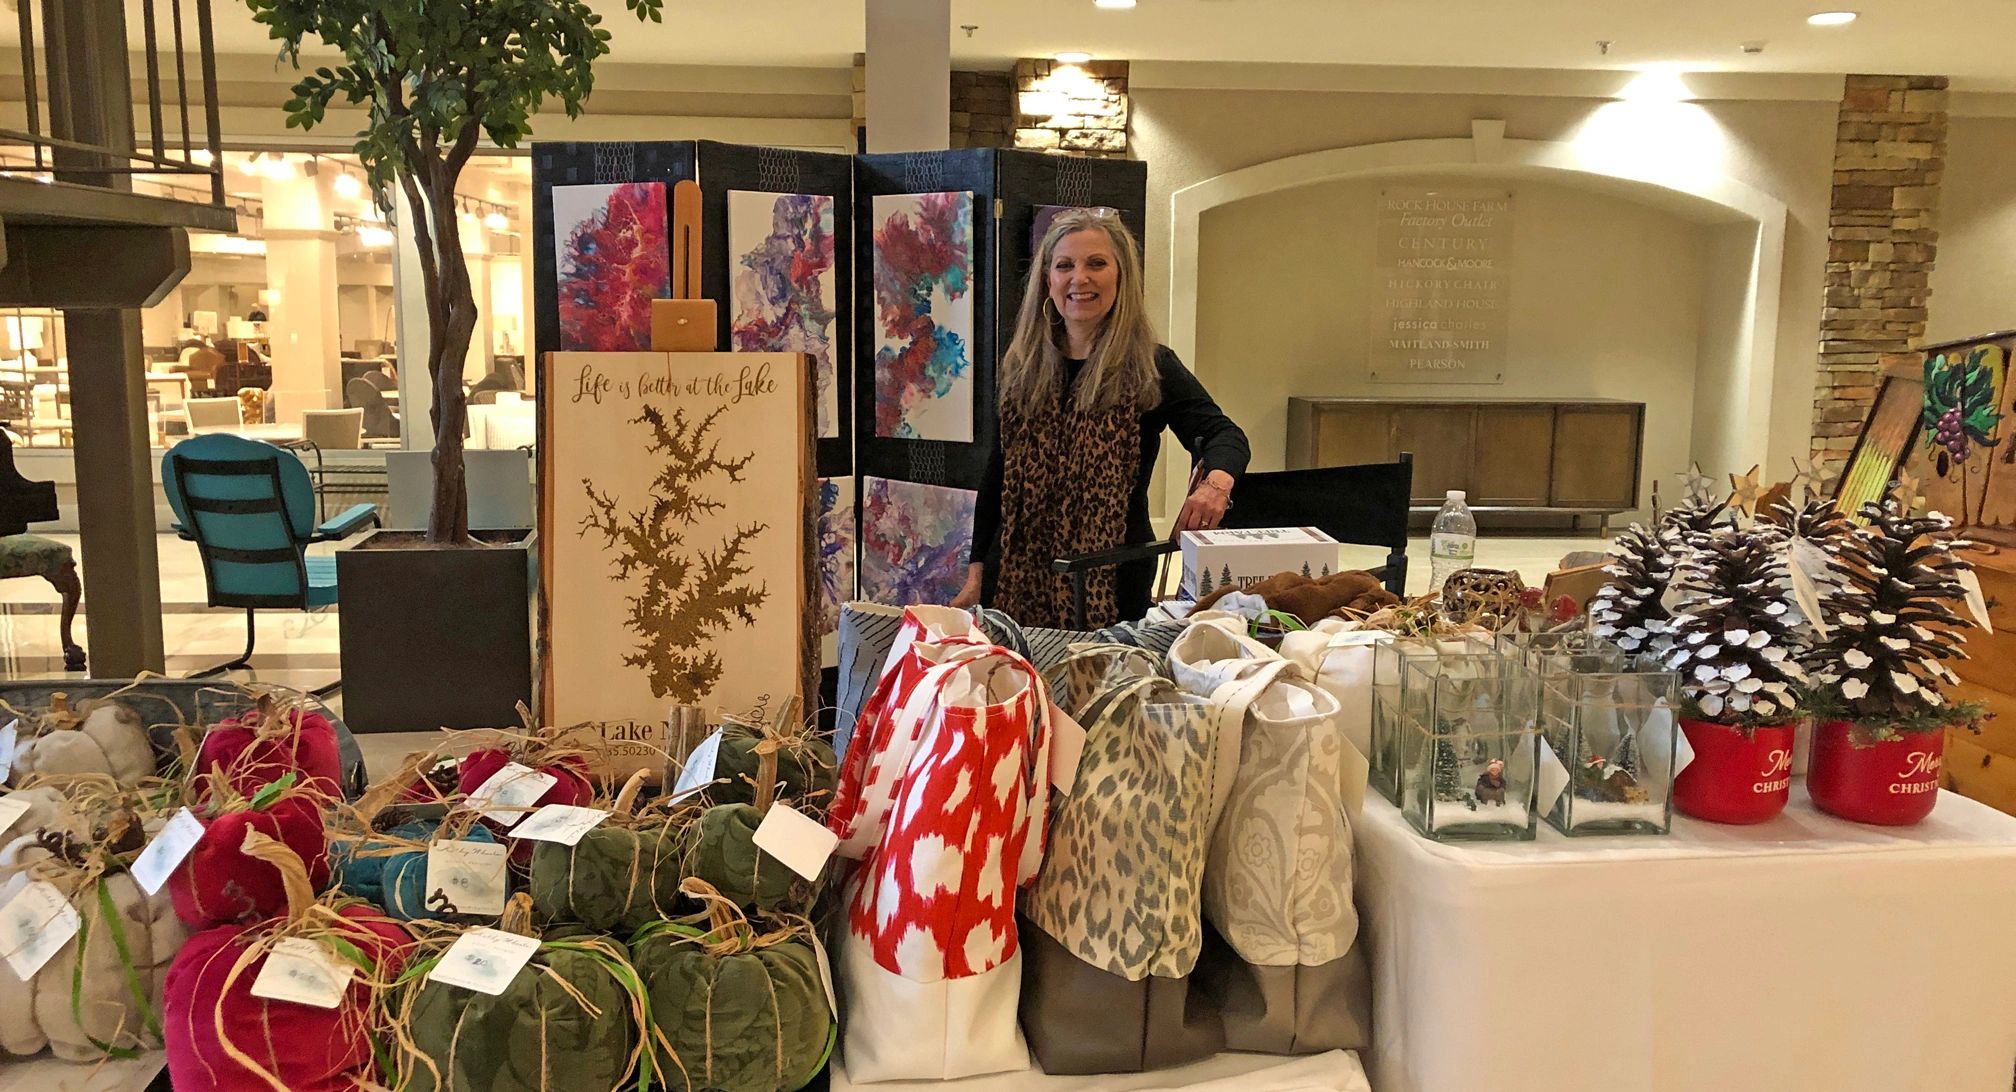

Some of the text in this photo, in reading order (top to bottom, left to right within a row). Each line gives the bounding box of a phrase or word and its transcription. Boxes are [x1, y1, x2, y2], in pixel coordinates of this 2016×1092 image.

[1387, 200, 1508, 212] ROCK HOUSE FARM
[1400, 211, 1493, 229] Factory Outlet
[1398, 238, 1489, 249] CENTURY
[1388, 279, 1497, 289] HICKORY CHAIR
[1385, 298, 1497, 309] HIGHLAND HOUSE
[1392, 317, 1438, 331] jessica
[1409, 359, 1466, 369] PEARSON
[572, 361, 778, 405] Life is better at the Lake
[599, 721, 653, 740] Lake
[1753, 776, 1789, 794] CHRIST
[1889, 780, 1938, 794] CHRIST
